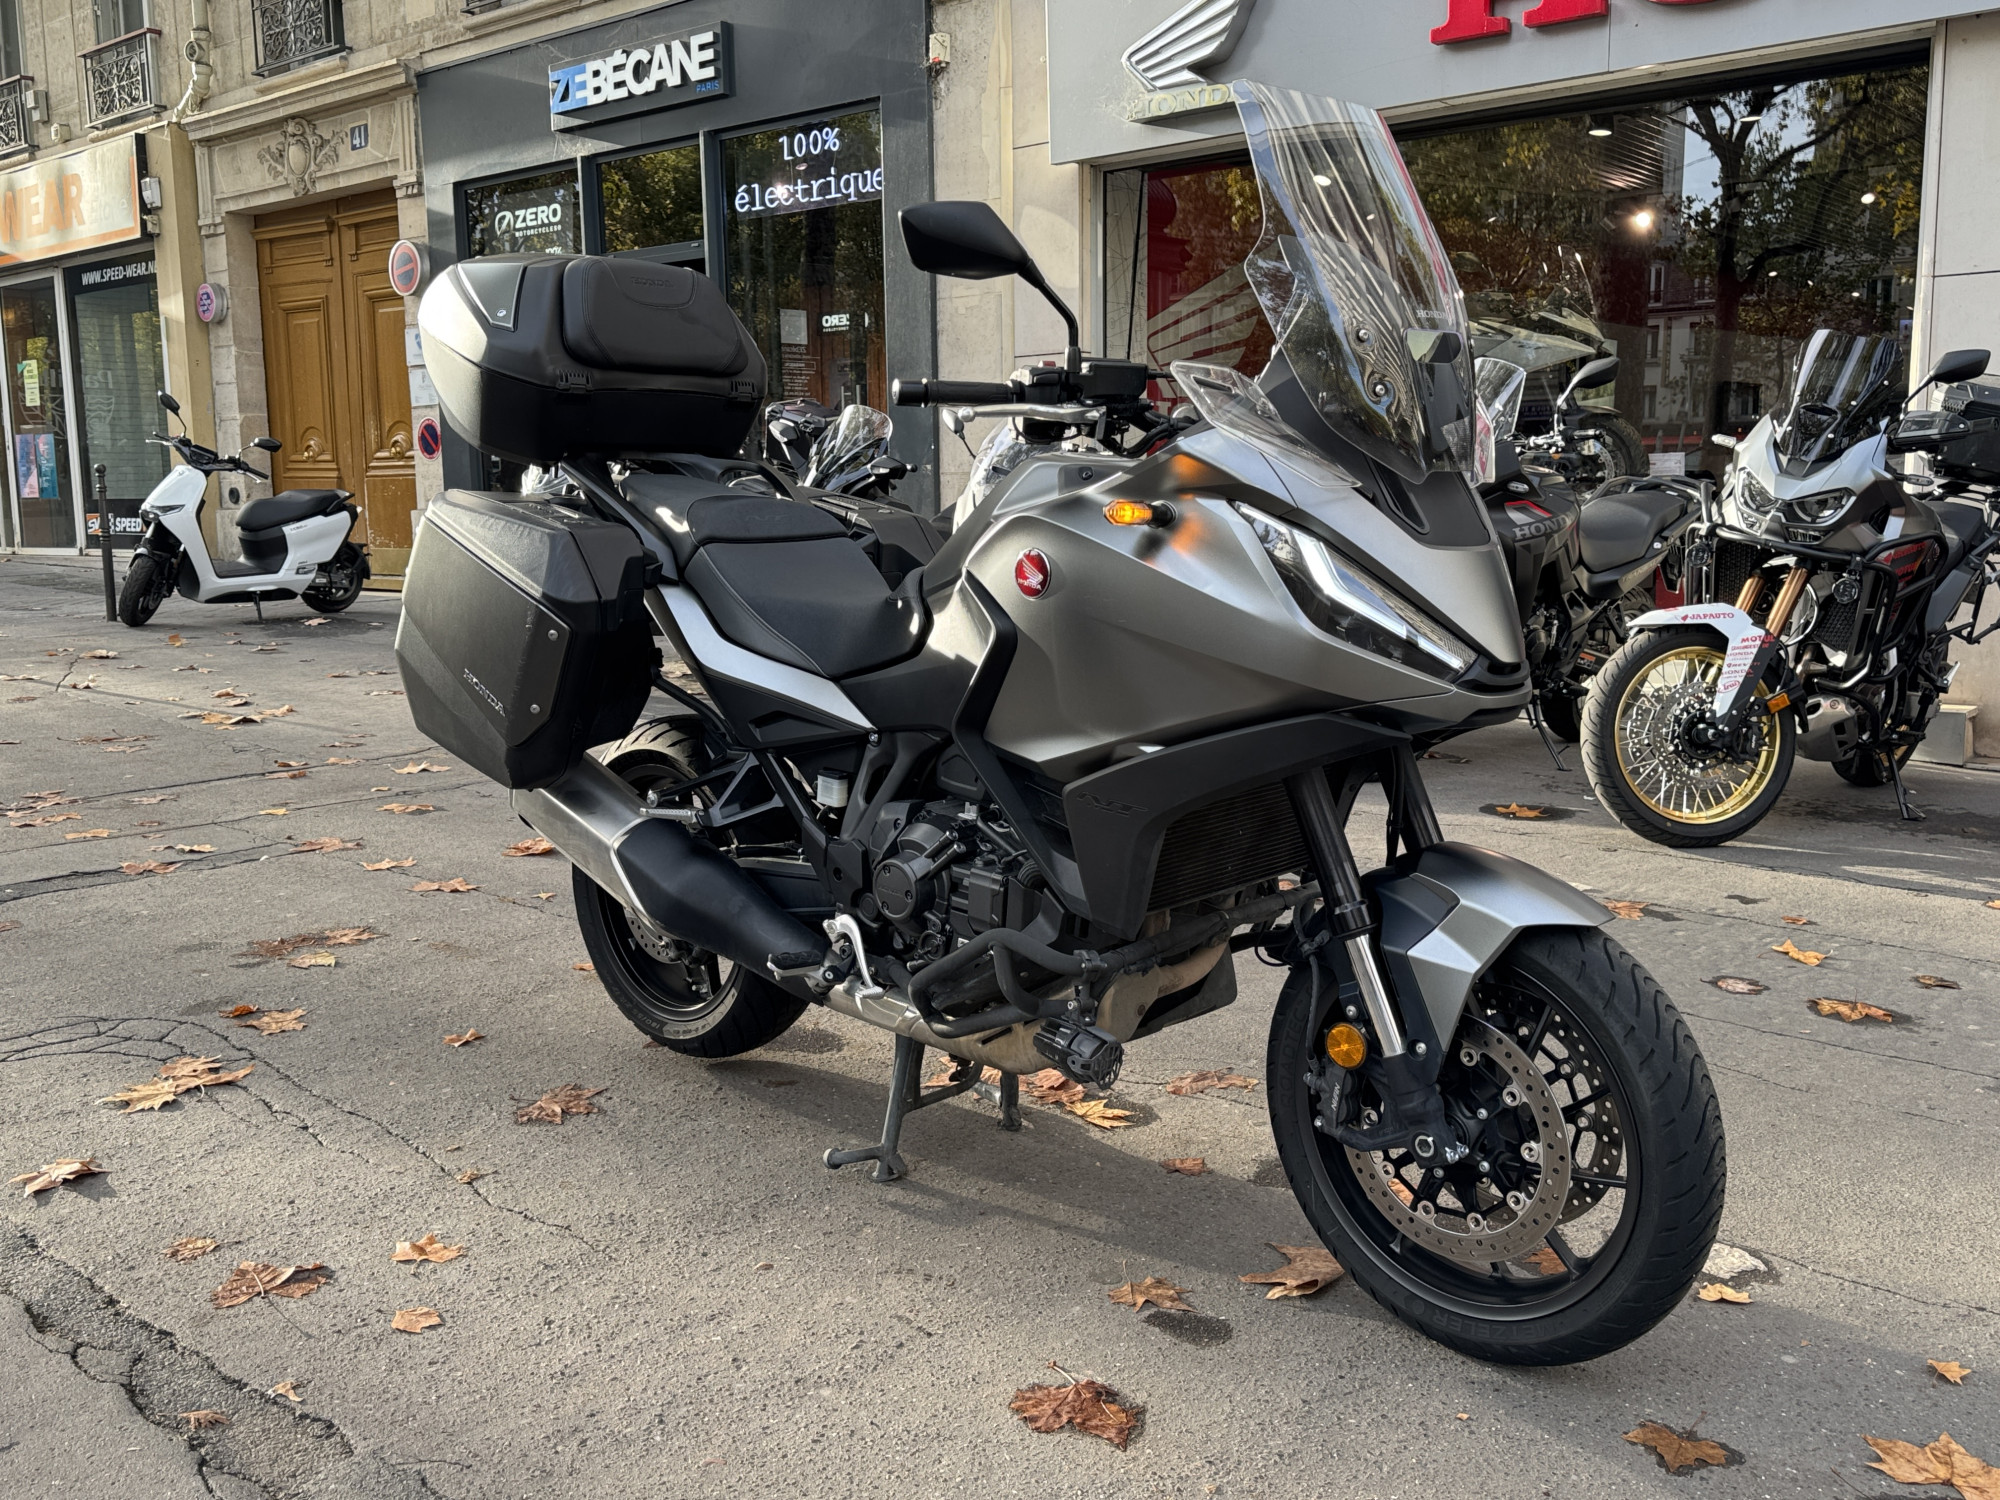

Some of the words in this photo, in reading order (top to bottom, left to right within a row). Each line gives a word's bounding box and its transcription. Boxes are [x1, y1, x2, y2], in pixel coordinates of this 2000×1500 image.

[696, 80, 720, 94] PARIS
[352, 125, 366, 148] 41
[779, 127, 841, 160] 100%
[735, 166, 883, 213] électrique
[515, 203, 562, 229] ZERO
[115, 517, 142, 532] SPEED
[1018, 578, 1042, 590] HONDA
[1689, 612, 1735, 620] JAPAUTO
[1741, 634, 1775, 643] MOTUL
[463, 667, 506, 718] HONDA
